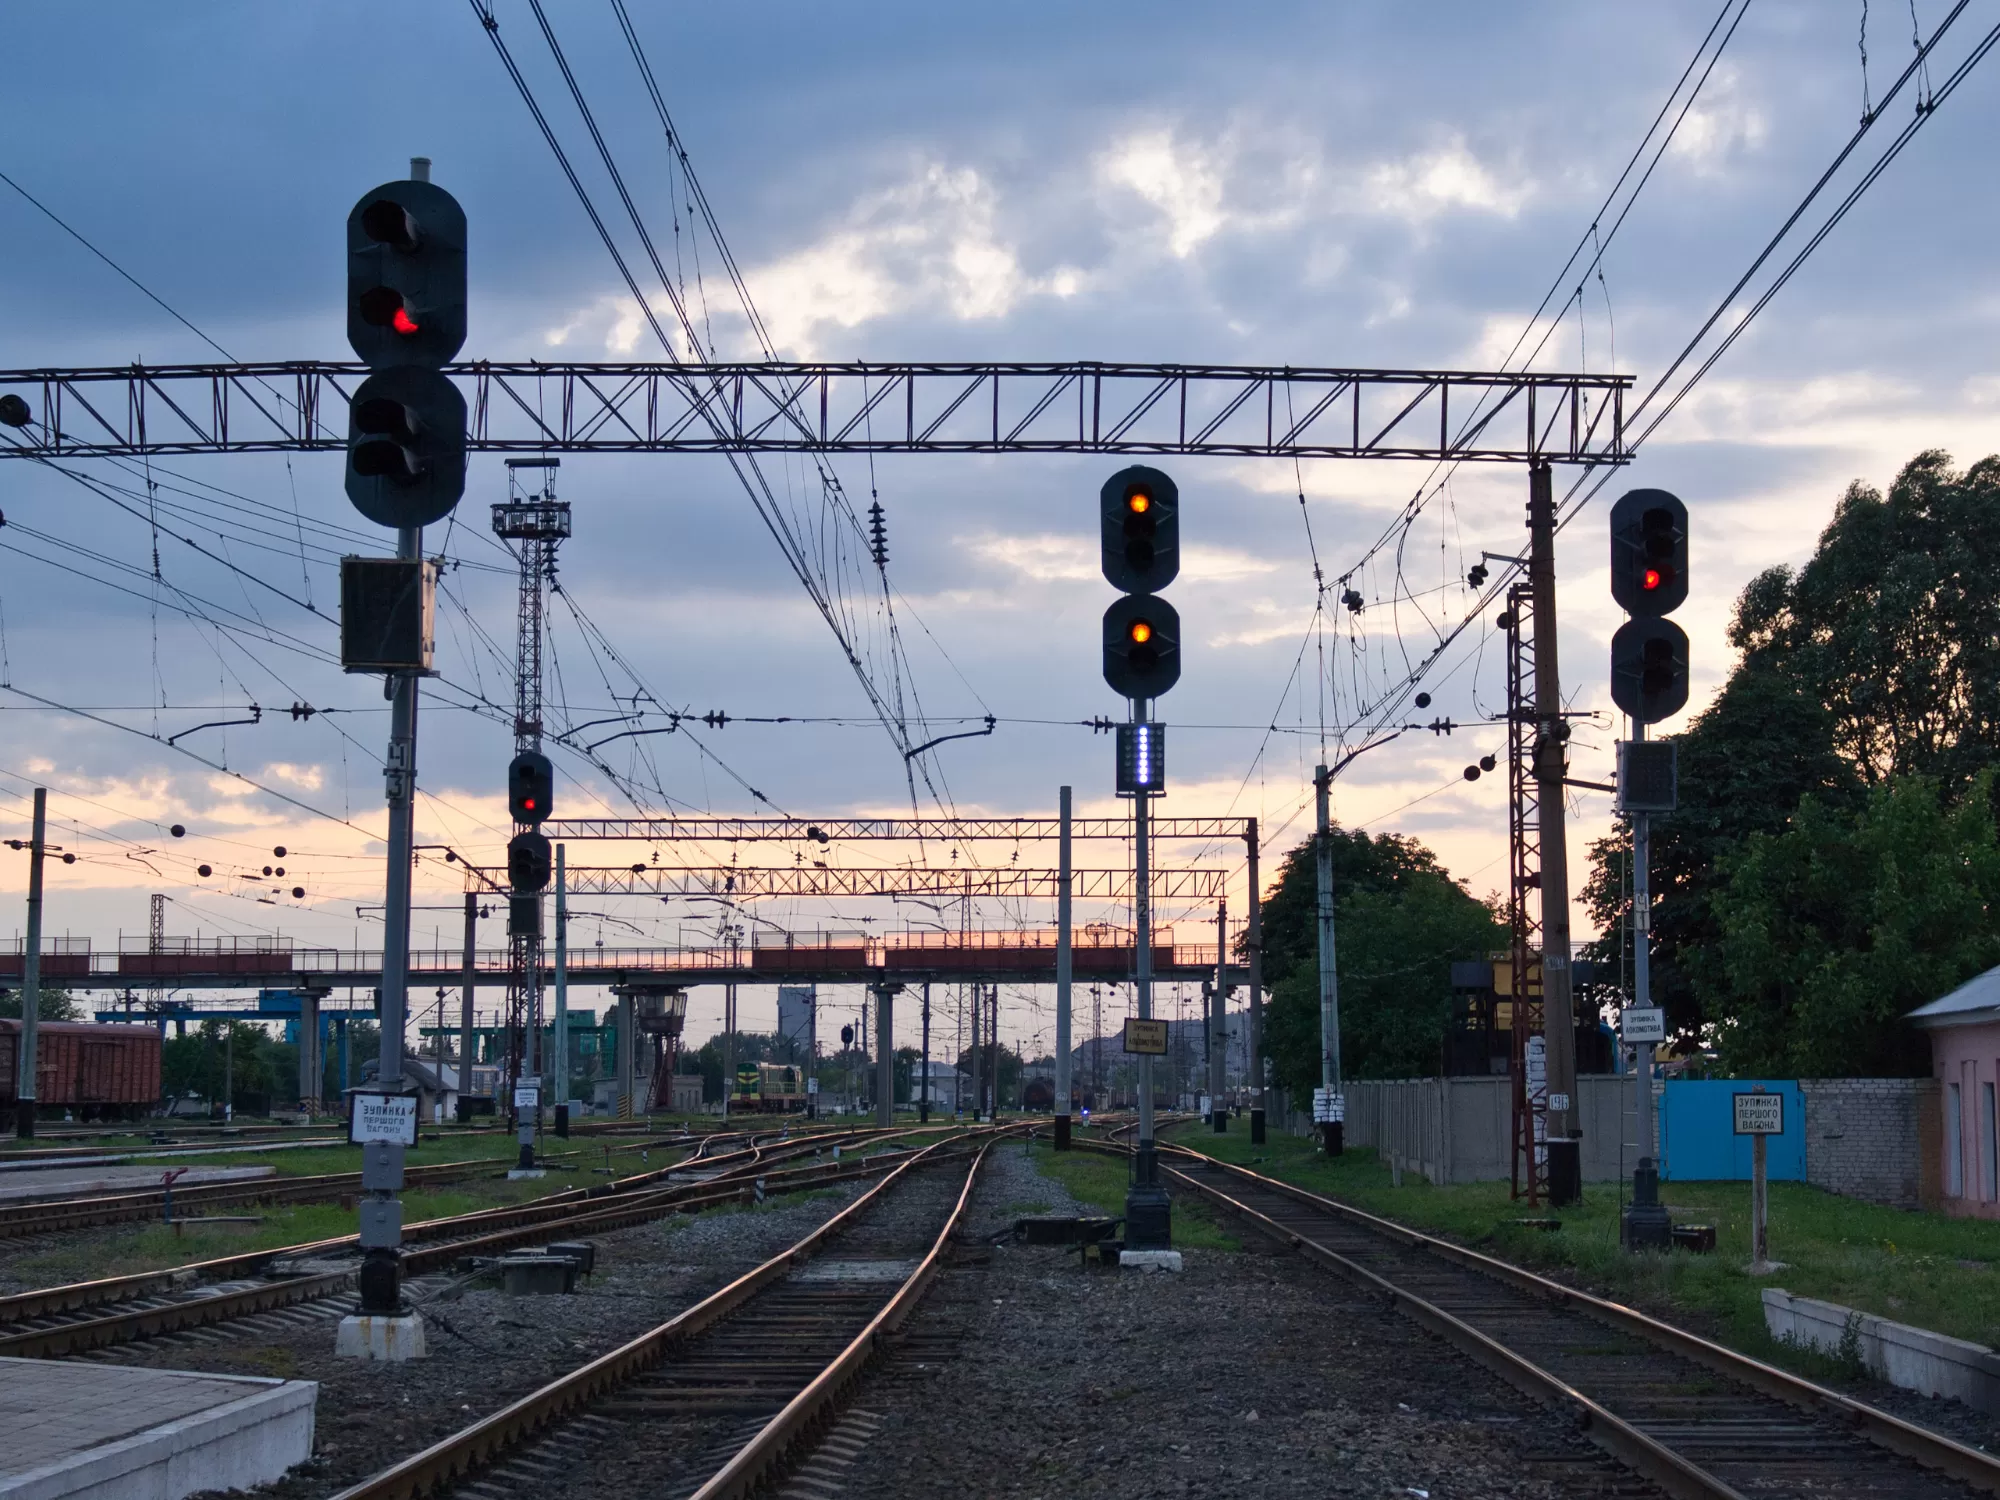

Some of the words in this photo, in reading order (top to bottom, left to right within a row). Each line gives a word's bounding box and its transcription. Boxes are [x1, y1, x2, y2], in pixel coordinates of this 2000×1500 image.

[1739, 1098, 1778, 1107] ЗУПИНКА
[363, 1105, 406, 1116] ЗУПИНКА
[1739, 1109, 1778, 1119] ПЕРШОГО
[363, 1116, 405, 1125] ПЕРШОГО
[1742, 1120, 1776, 1130] ВАГОНА
